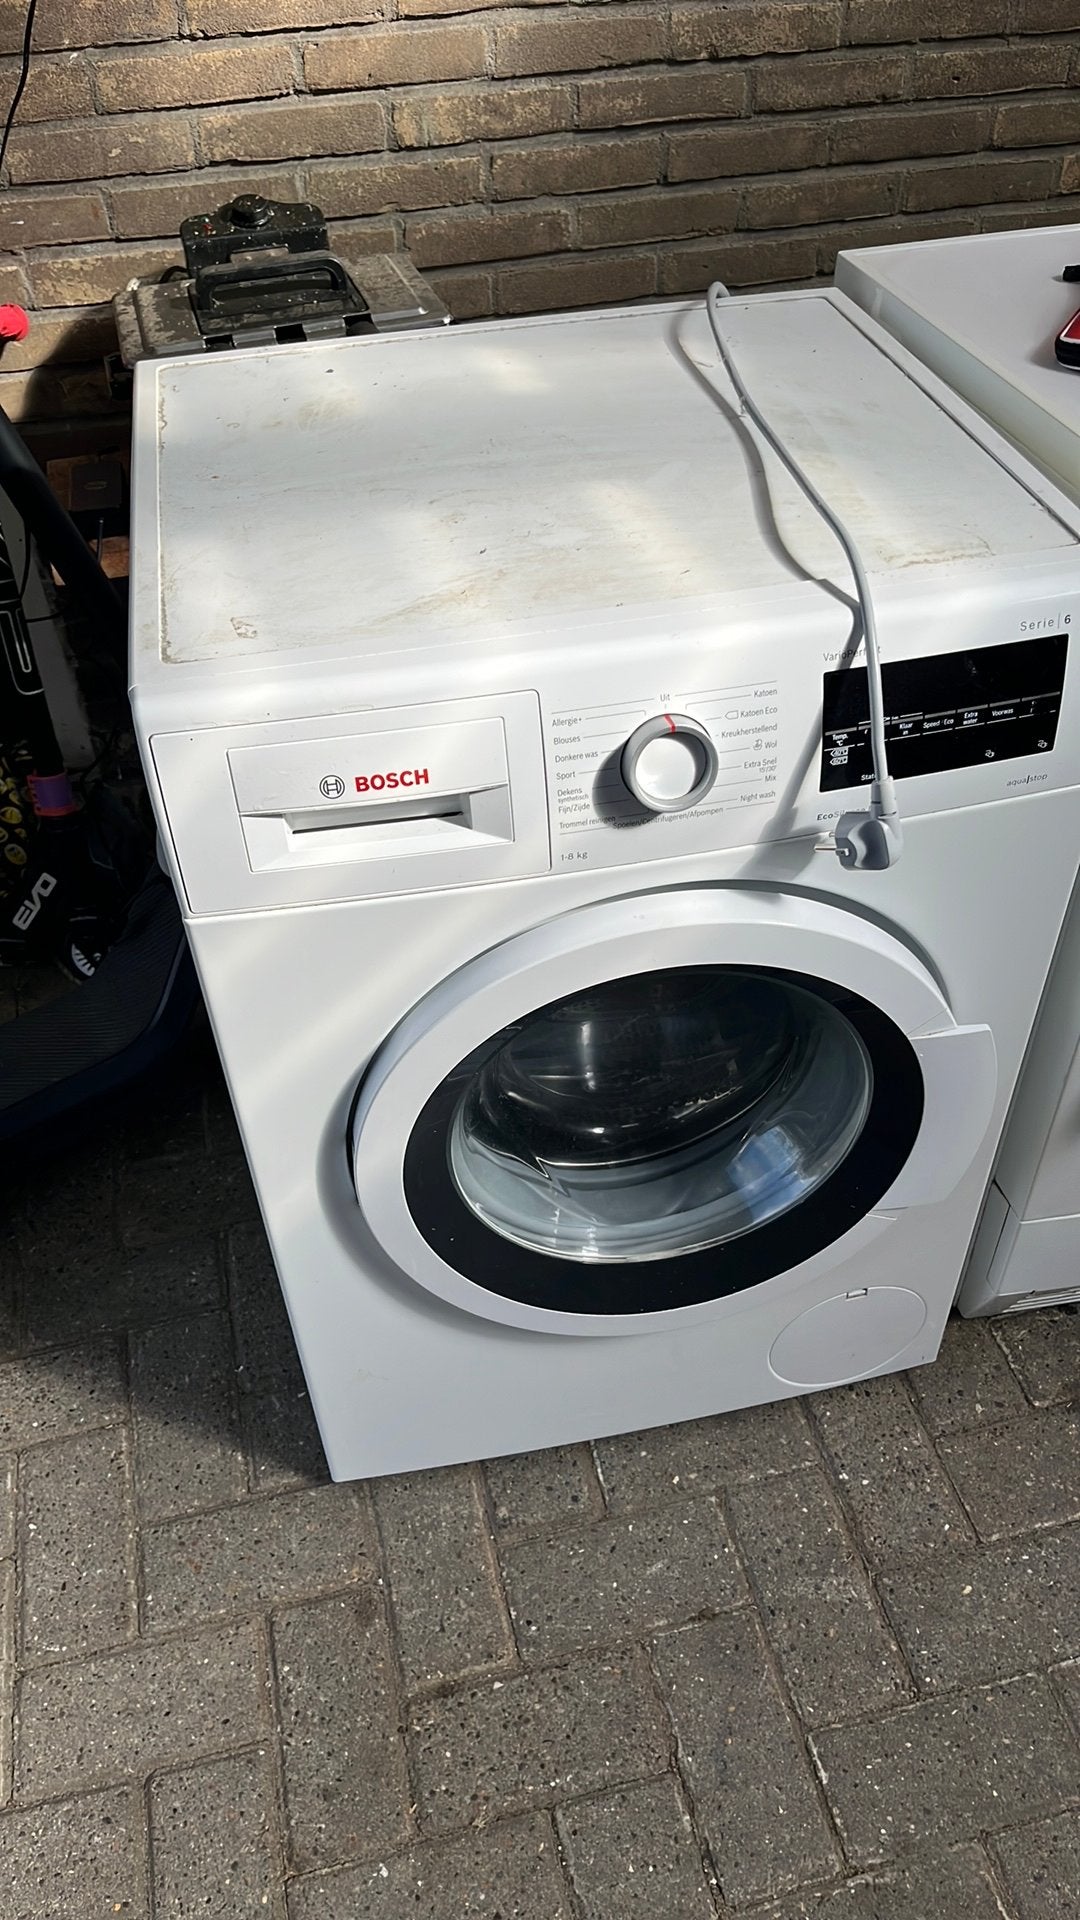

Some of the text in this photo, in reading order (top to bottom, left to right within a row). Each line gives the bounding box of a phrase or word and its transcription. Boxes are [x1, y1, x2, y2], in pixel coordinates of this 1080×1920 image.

[1019, 614, 1072, 632] Serie 6
[660, 693, 671, 702] Uit
[753, 688, 778, 699] Katoen
[740, 706, 778, 719] Katoen Eco
[963, 711, 979, 719] Extra
[991, 708, 1015, 717] Voorwas
[551, 717, 582, 728] Allergie+
[922, 720, 941, 730] Speed
[721, 724, 778, 739] Kreukherstellend
[553, 735, 581, 746] Blouses
[764, 741, 778, 750] Wol
[554, 751, 599, 764] Donkere was
[743, 756, 778, 770] Extra Snel
[354, 768, 430, 793] BOSCH
[556, 771, 576, 781] Sport
[764, 774, 777, 783] Mix
[557, 788, 583, 798] Dekens
[740, 791, 776, 803] Night wash
[558, 803, 591, 815] Fijn/Zijde
[560, 815, 617, 830] Trommel reinigen
[561, 851, 589, 862] 1-8 kg
[12, 871, 57, 931] EVO
